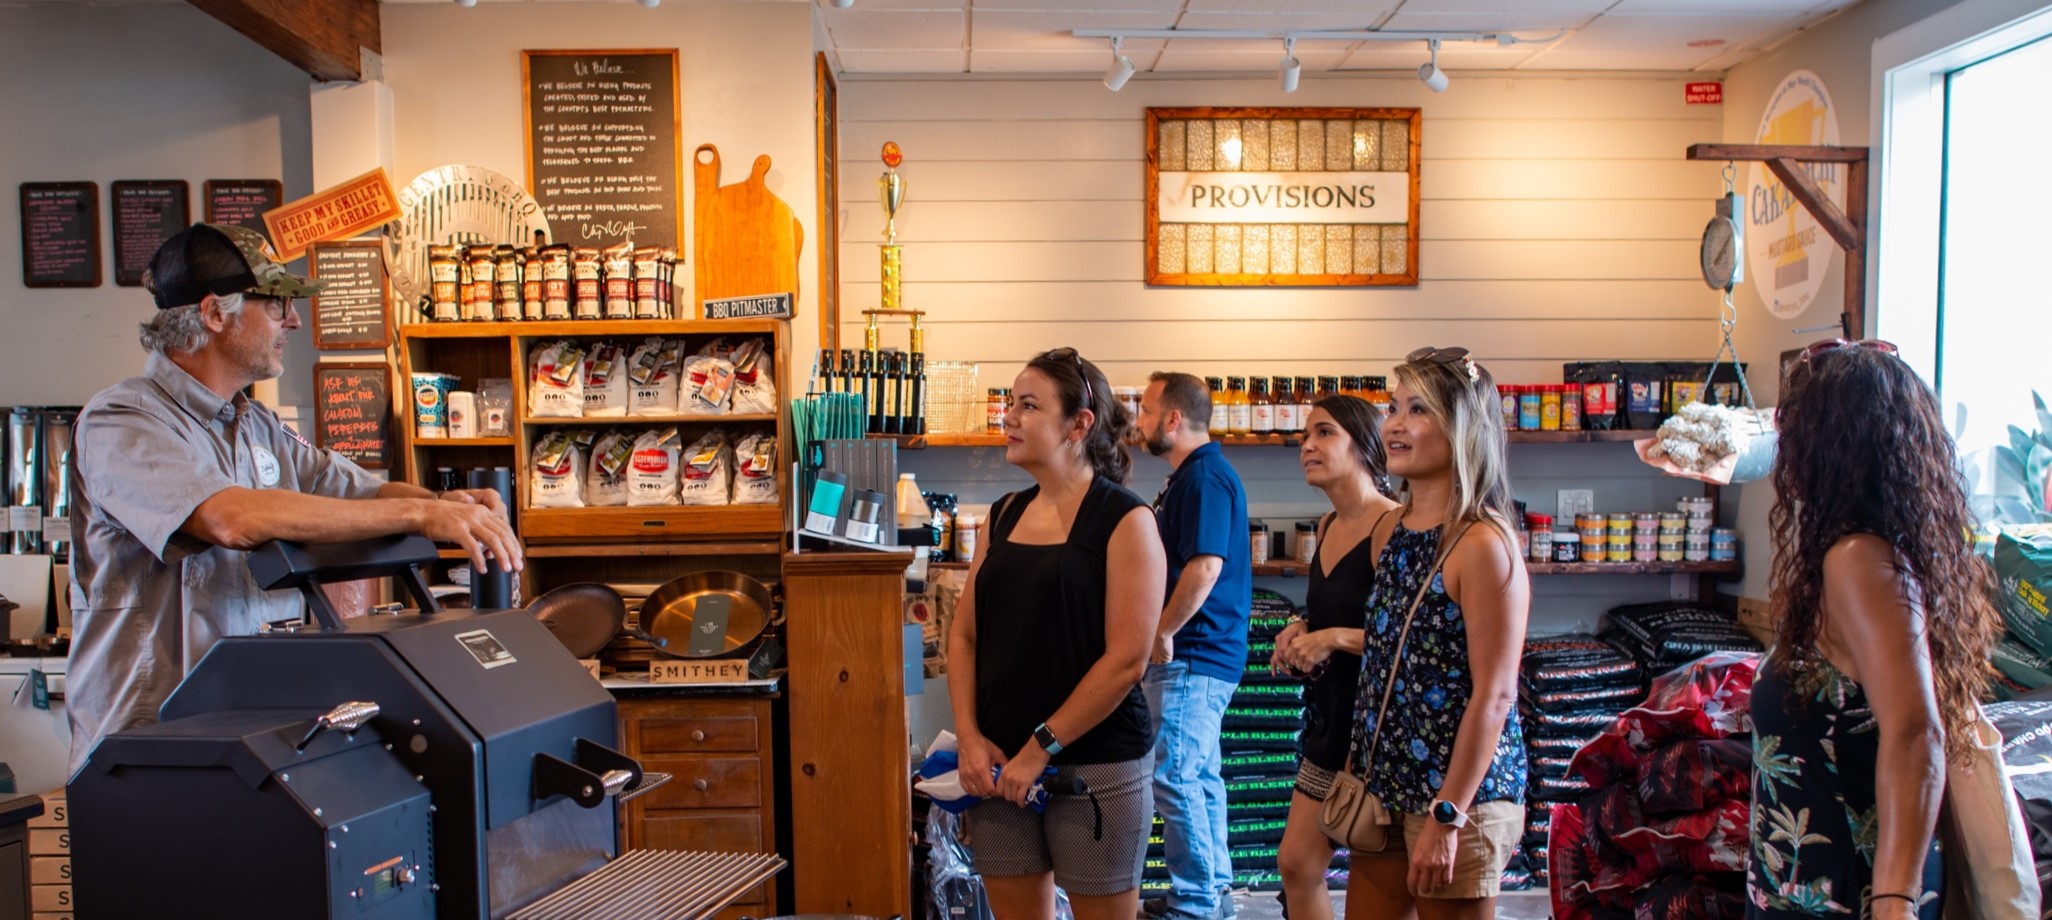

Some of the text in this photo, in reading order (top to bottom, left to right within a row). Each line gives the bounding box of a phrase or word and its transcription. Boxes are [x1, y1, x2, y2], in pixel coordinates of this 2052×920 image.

[1691, 85, 1716, 93] WATER
[1191, 184, 1376, 208] PROVISIONS
[279, 182, 382, 234] KEEP MY SKILLET
[294, 199, 381, 244] GOOD AND GREASY
[1768, 225, 1816, 260] MUSTARD SAUCE
[712, 298, 778, 318] BBQ PITMASTER
[324, 375, 361, 389] ASK US
[328, 390, 355, 404] ABOUT
[324, 406, 362, 422] CUSTOM
[653, 665, 743, 678] SMITHEY
[1221, 731, 1248, 739] PLE
[1247, 755, 1295, 764] BLEND
[1249, 780, 1296, 789] BLEND
[1249, 821, 1286, 831] BLEN
[1249, 849, 1277, 858] BLE
